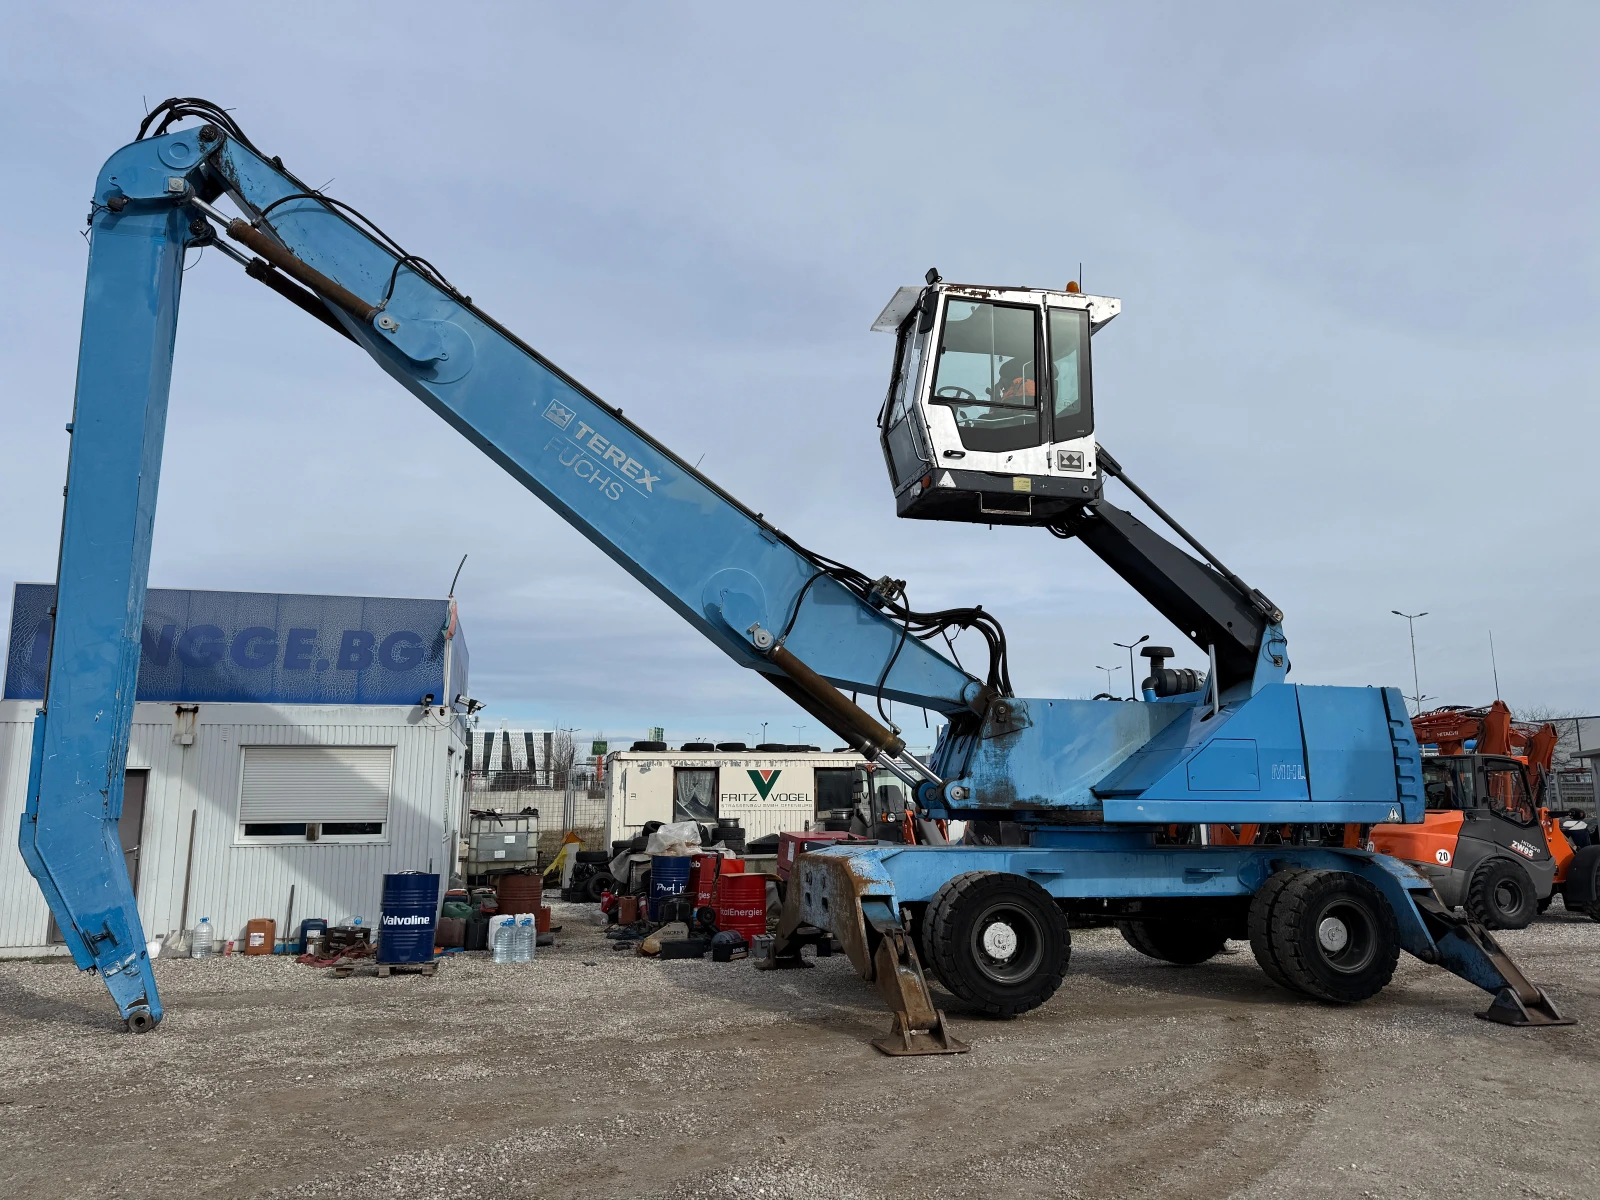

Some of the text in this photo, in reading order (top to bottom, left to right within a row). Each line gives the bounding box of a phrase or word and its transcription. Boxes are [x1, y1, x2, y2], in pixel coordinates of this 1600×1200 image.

[575, 420, 661, 493] TEREX
[543, 436, 624, 500] FUCHS
[1271, 764, 1306, 780] MHL
[721, 793, 812, 802] FRITZ VOGEL
[1511, 840, 1534, 857] ZW95
[1438, 852, 1449, 862] 20
[721, 908, 763, 918] talEnergies
[383, 915, 430, 926] Valvoline
